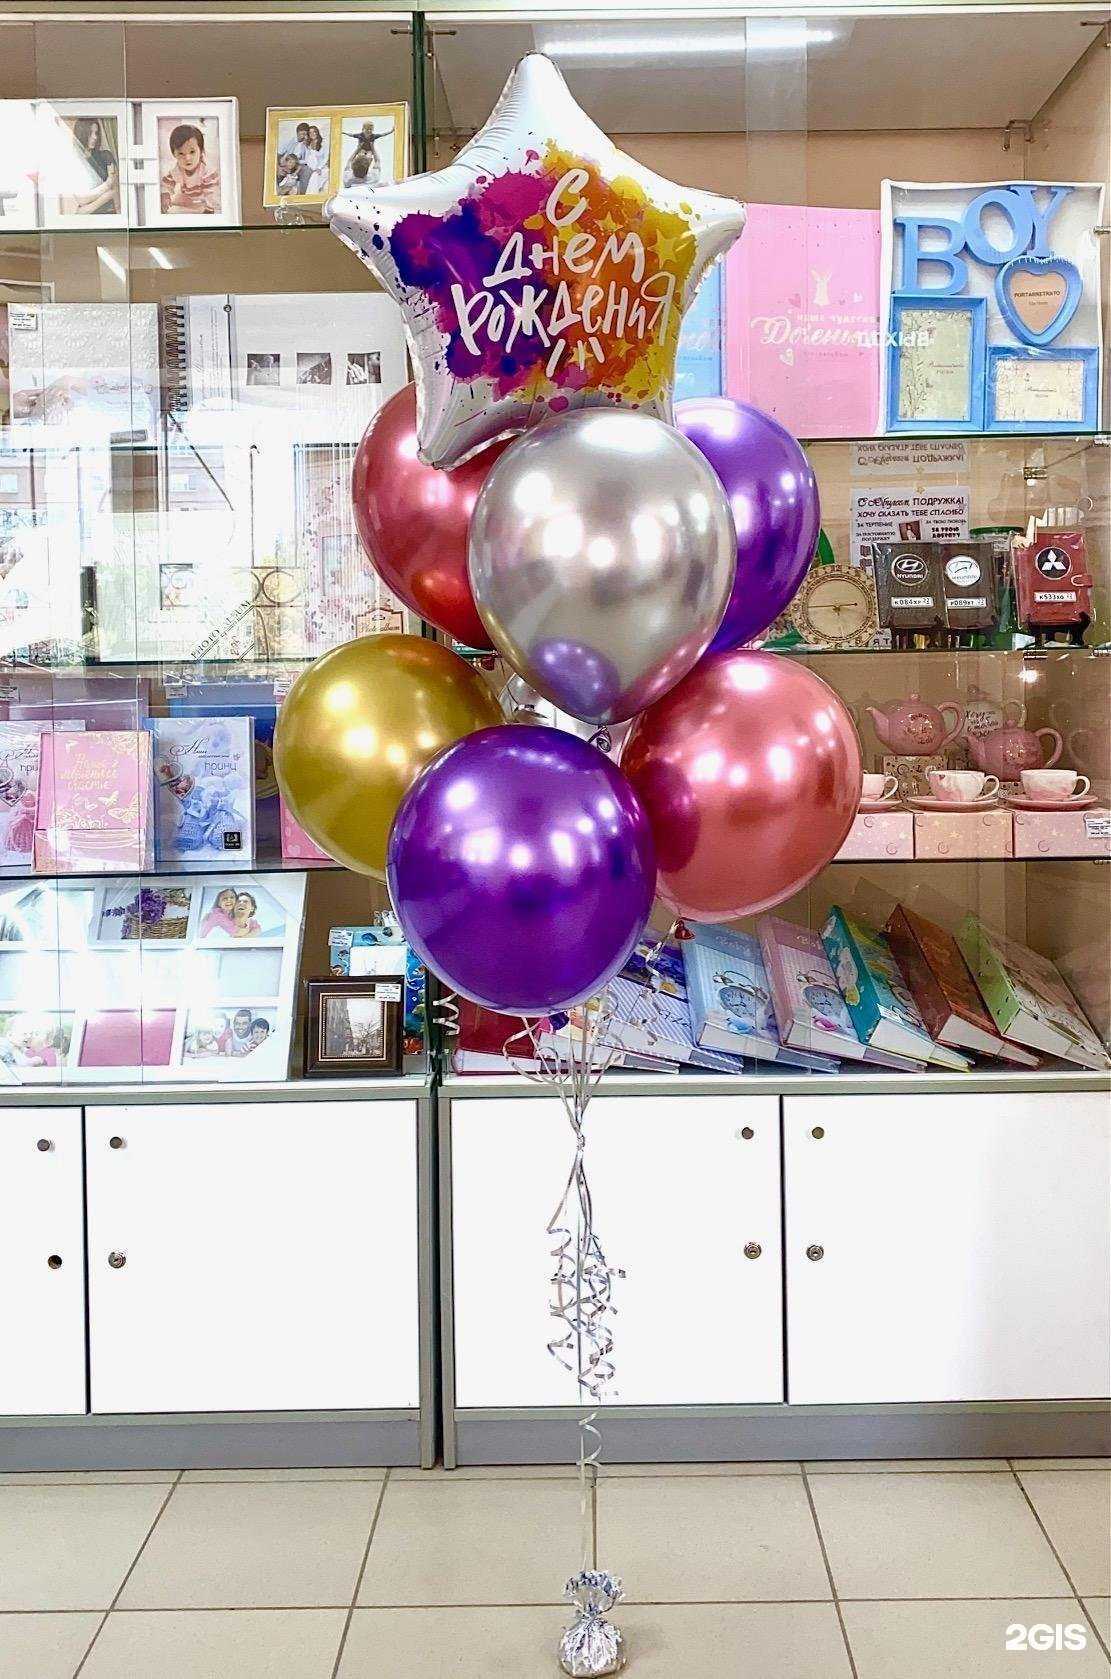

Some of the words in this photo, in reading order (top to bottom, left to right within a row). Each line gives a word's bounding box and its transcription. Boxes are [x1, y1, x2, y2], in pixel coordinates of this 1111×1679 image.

[893, 185, 1074, 296] BOY
[913, 496, 964, 506] ПОДРУЖКА!
[878, 510, 909, 518] СКАЗАТЬ
[911, 509, 928, 517] ТЕБЕ
[930, 508, 964, 516] СПАСИБО
